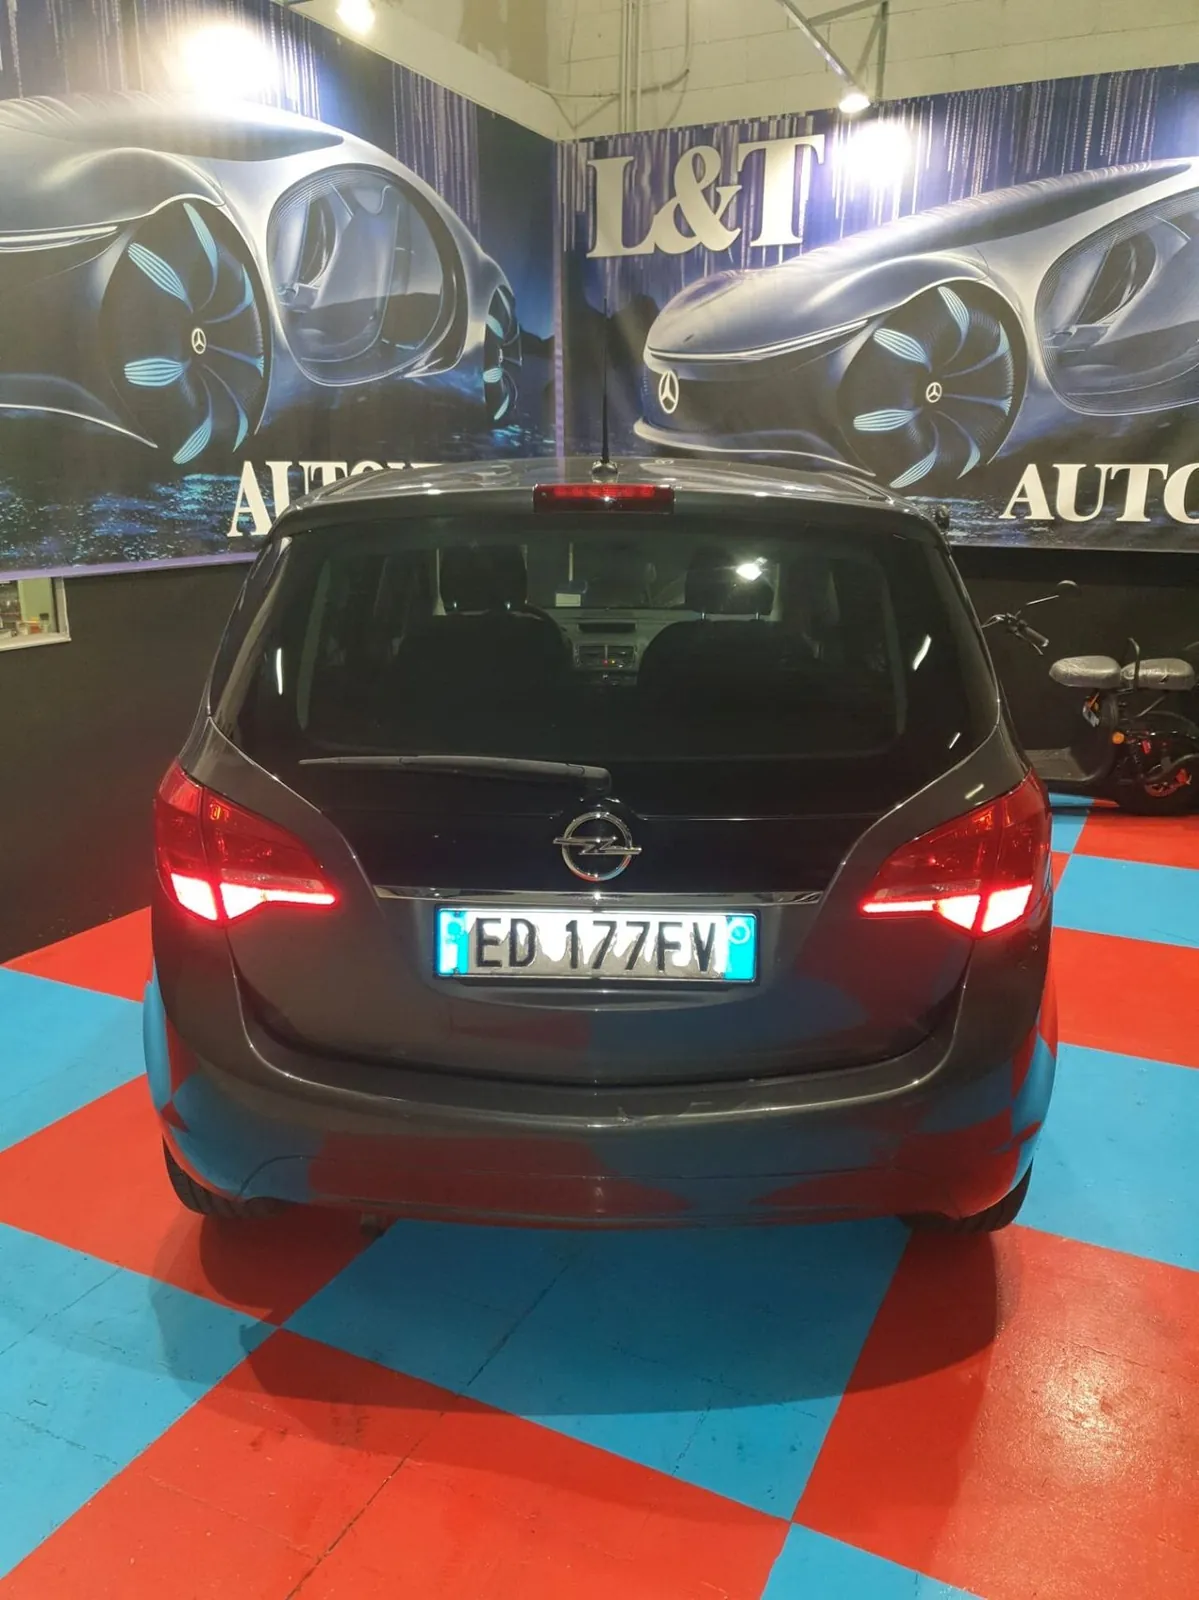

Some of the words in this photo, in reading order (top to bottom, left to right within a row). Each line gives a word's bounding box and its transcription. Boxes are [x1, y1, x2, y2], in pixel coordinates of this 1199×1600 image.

[586, 134, 825, 258] L&T
[476, 917, 537, 968] ED
[565, 919, 716, 972] 177FV
